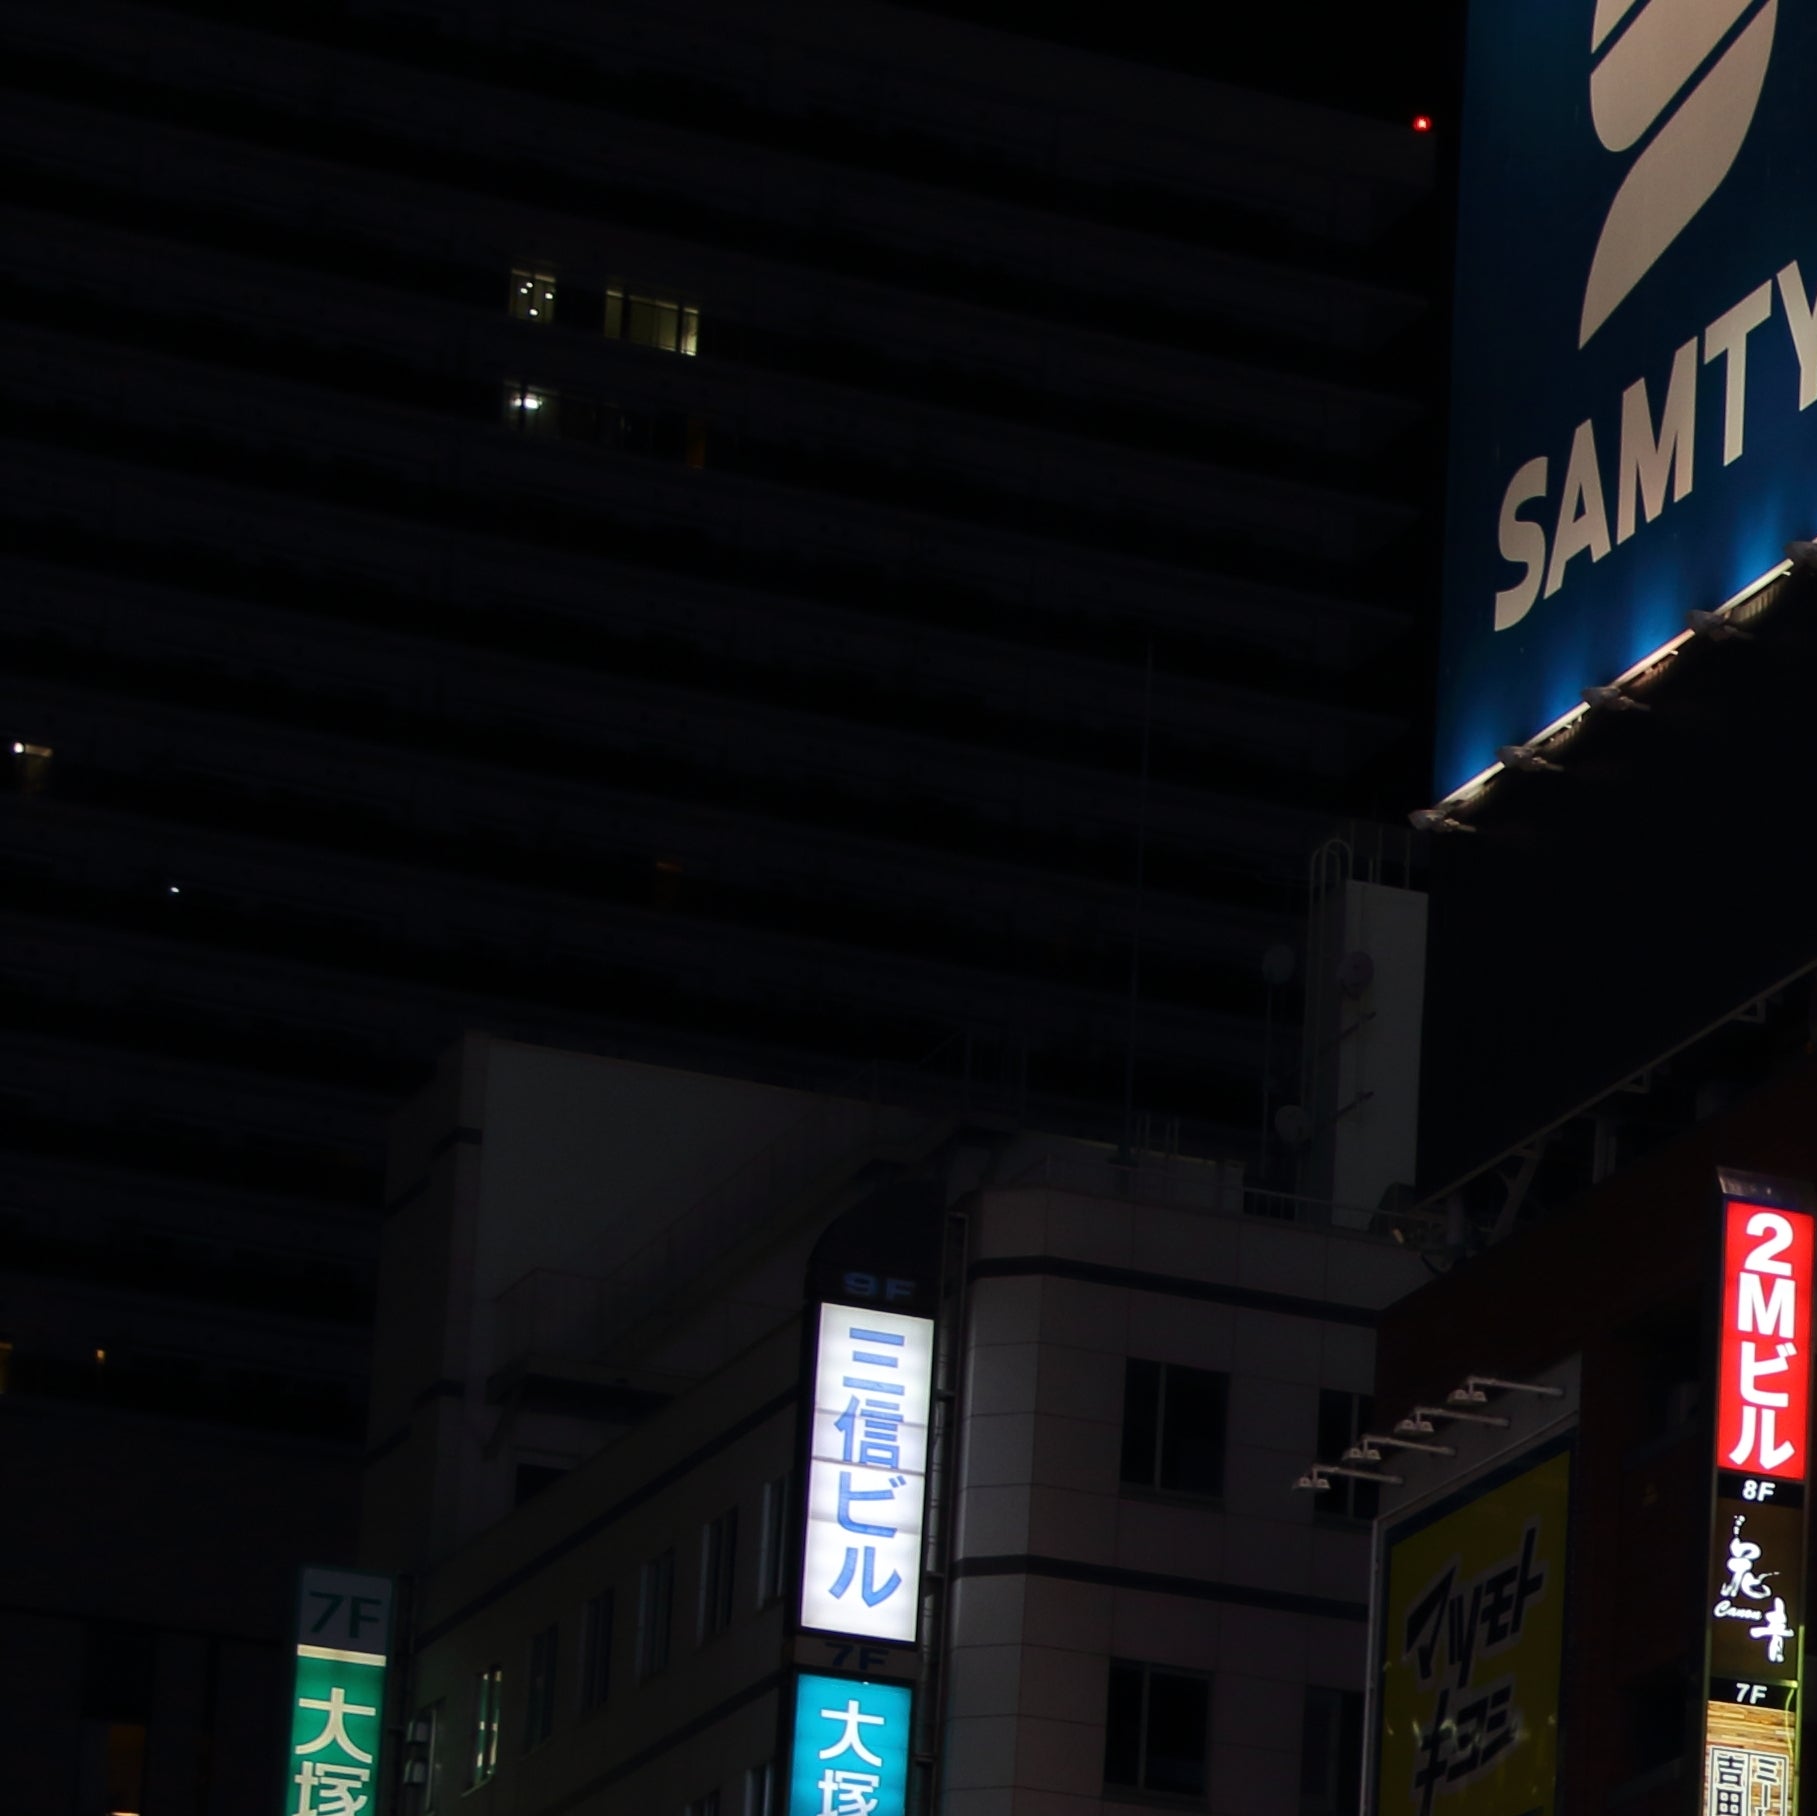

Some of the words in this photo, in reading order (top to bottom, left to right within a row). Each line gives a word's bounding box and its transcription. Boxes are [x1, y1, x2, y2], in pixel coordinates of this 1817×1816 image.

[1729, 1212, 1797, 1470] 2Mビル
[828, 1327, 906, 1607] 三信ビル
[1742, 1480, 1776, 1502] 8F
[308, 1590, 384, 1640] 7F
[1736, 1683, 1768, 1704] 7F
